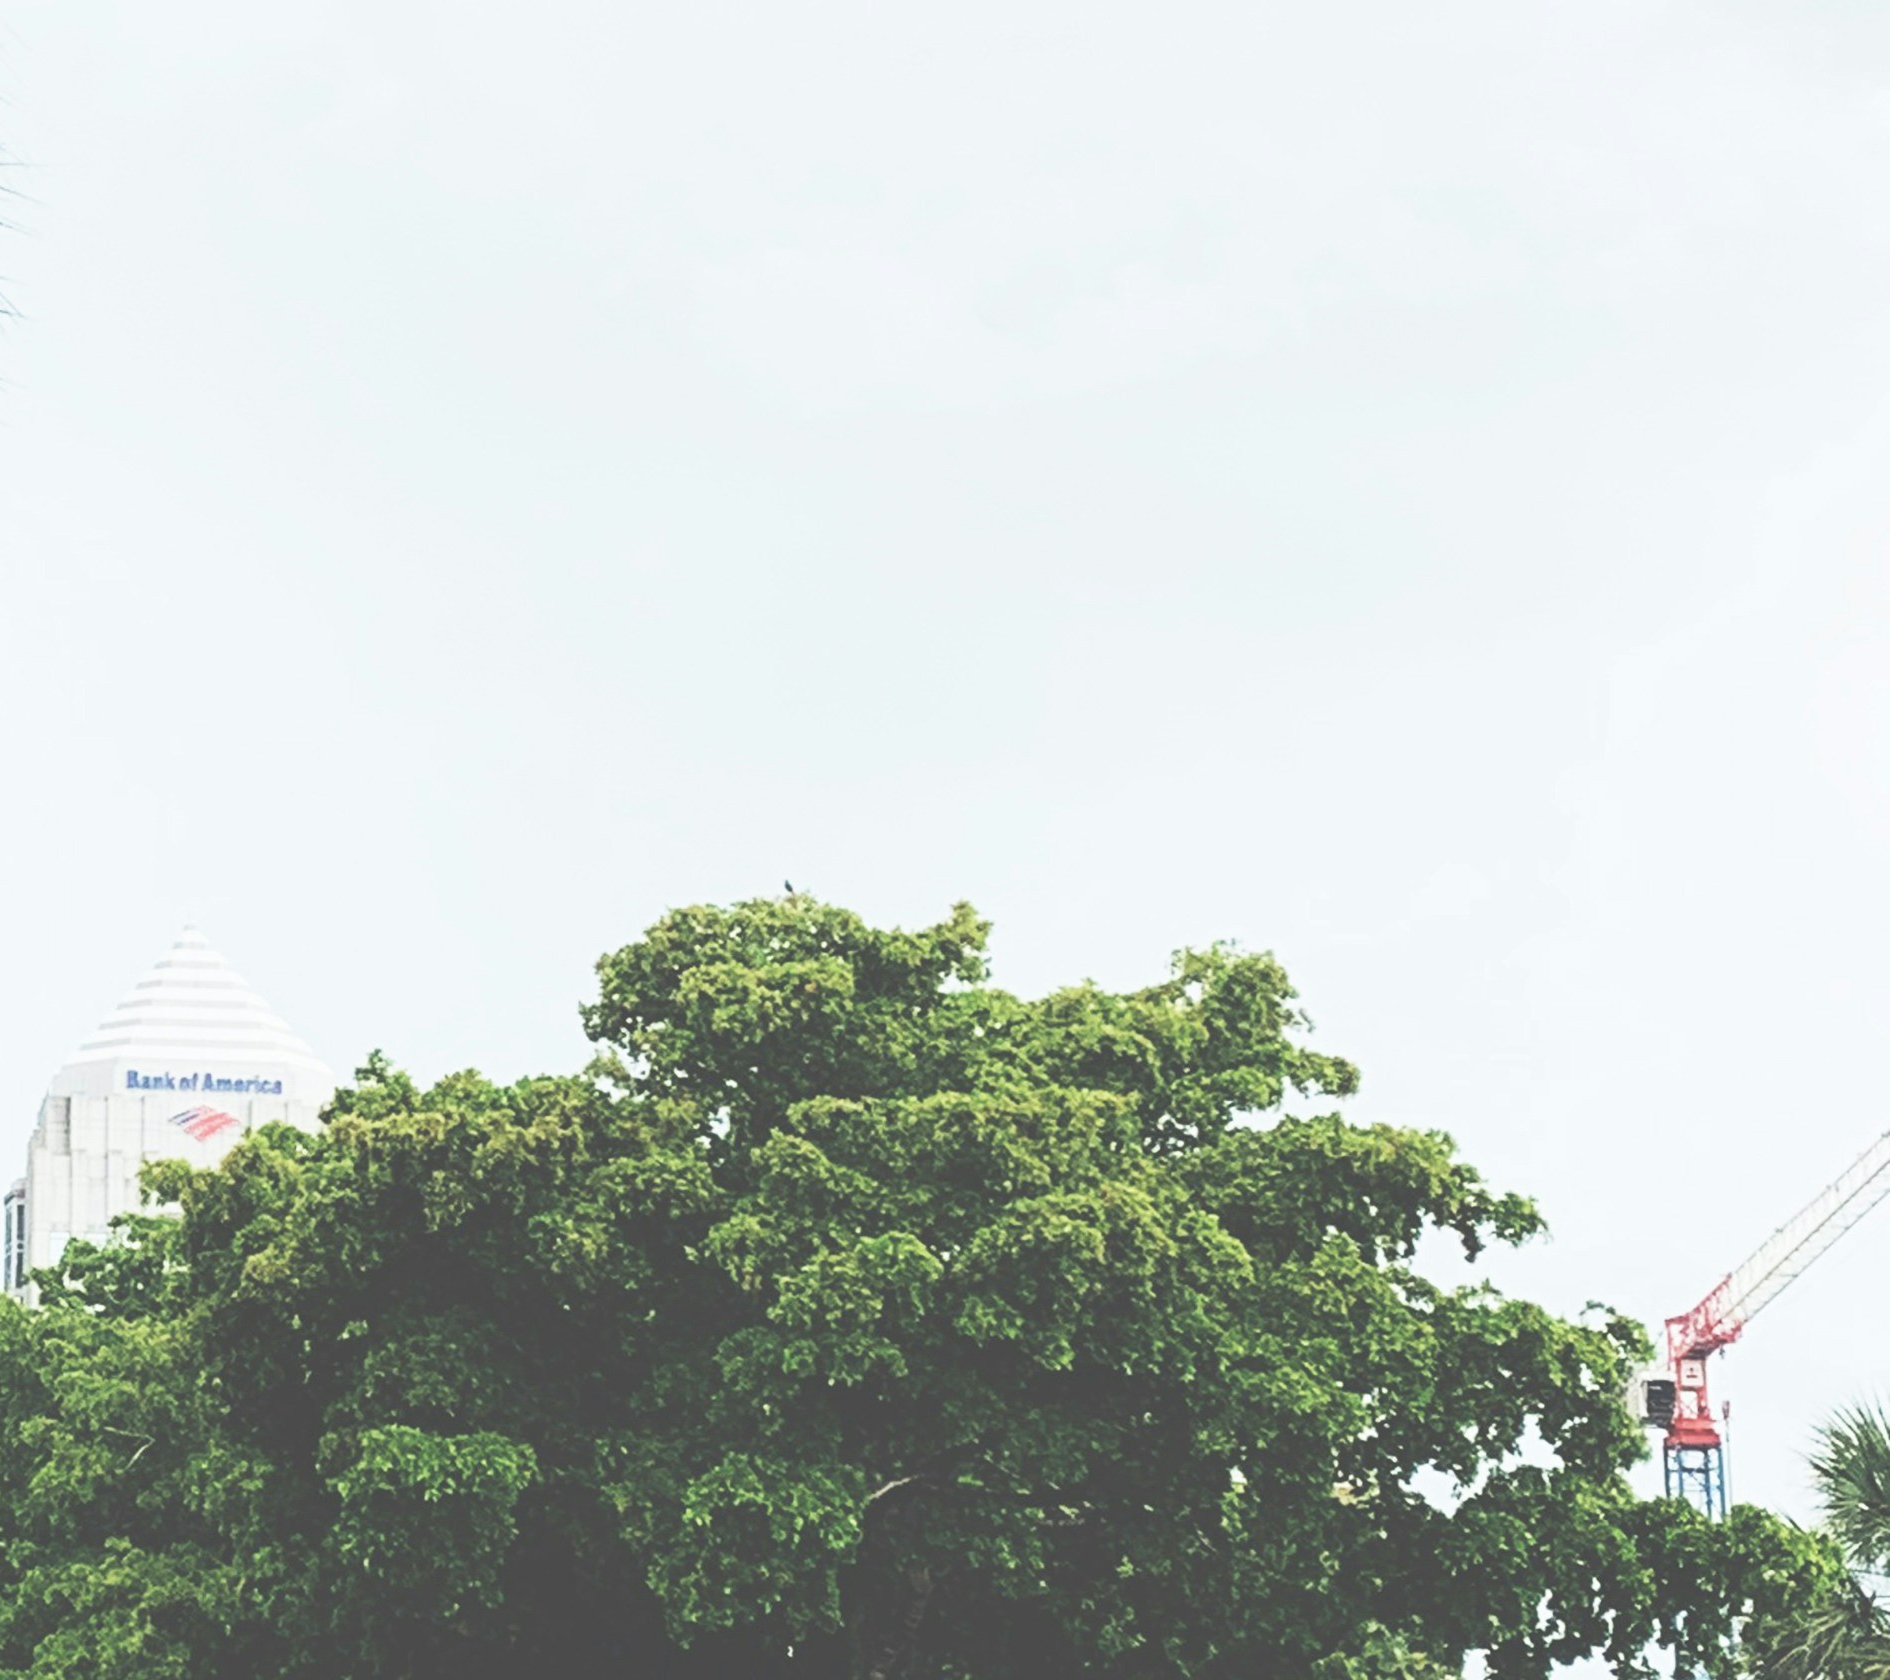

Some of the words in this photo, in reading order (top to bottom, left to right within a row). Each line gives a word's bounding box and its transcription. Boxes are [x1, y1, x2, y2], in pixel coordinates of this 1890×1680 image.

[126, 1070, 175, 1090] Bank
[179, 1072, 199, 1091] of
[202, 1073, 282, 1094] America
